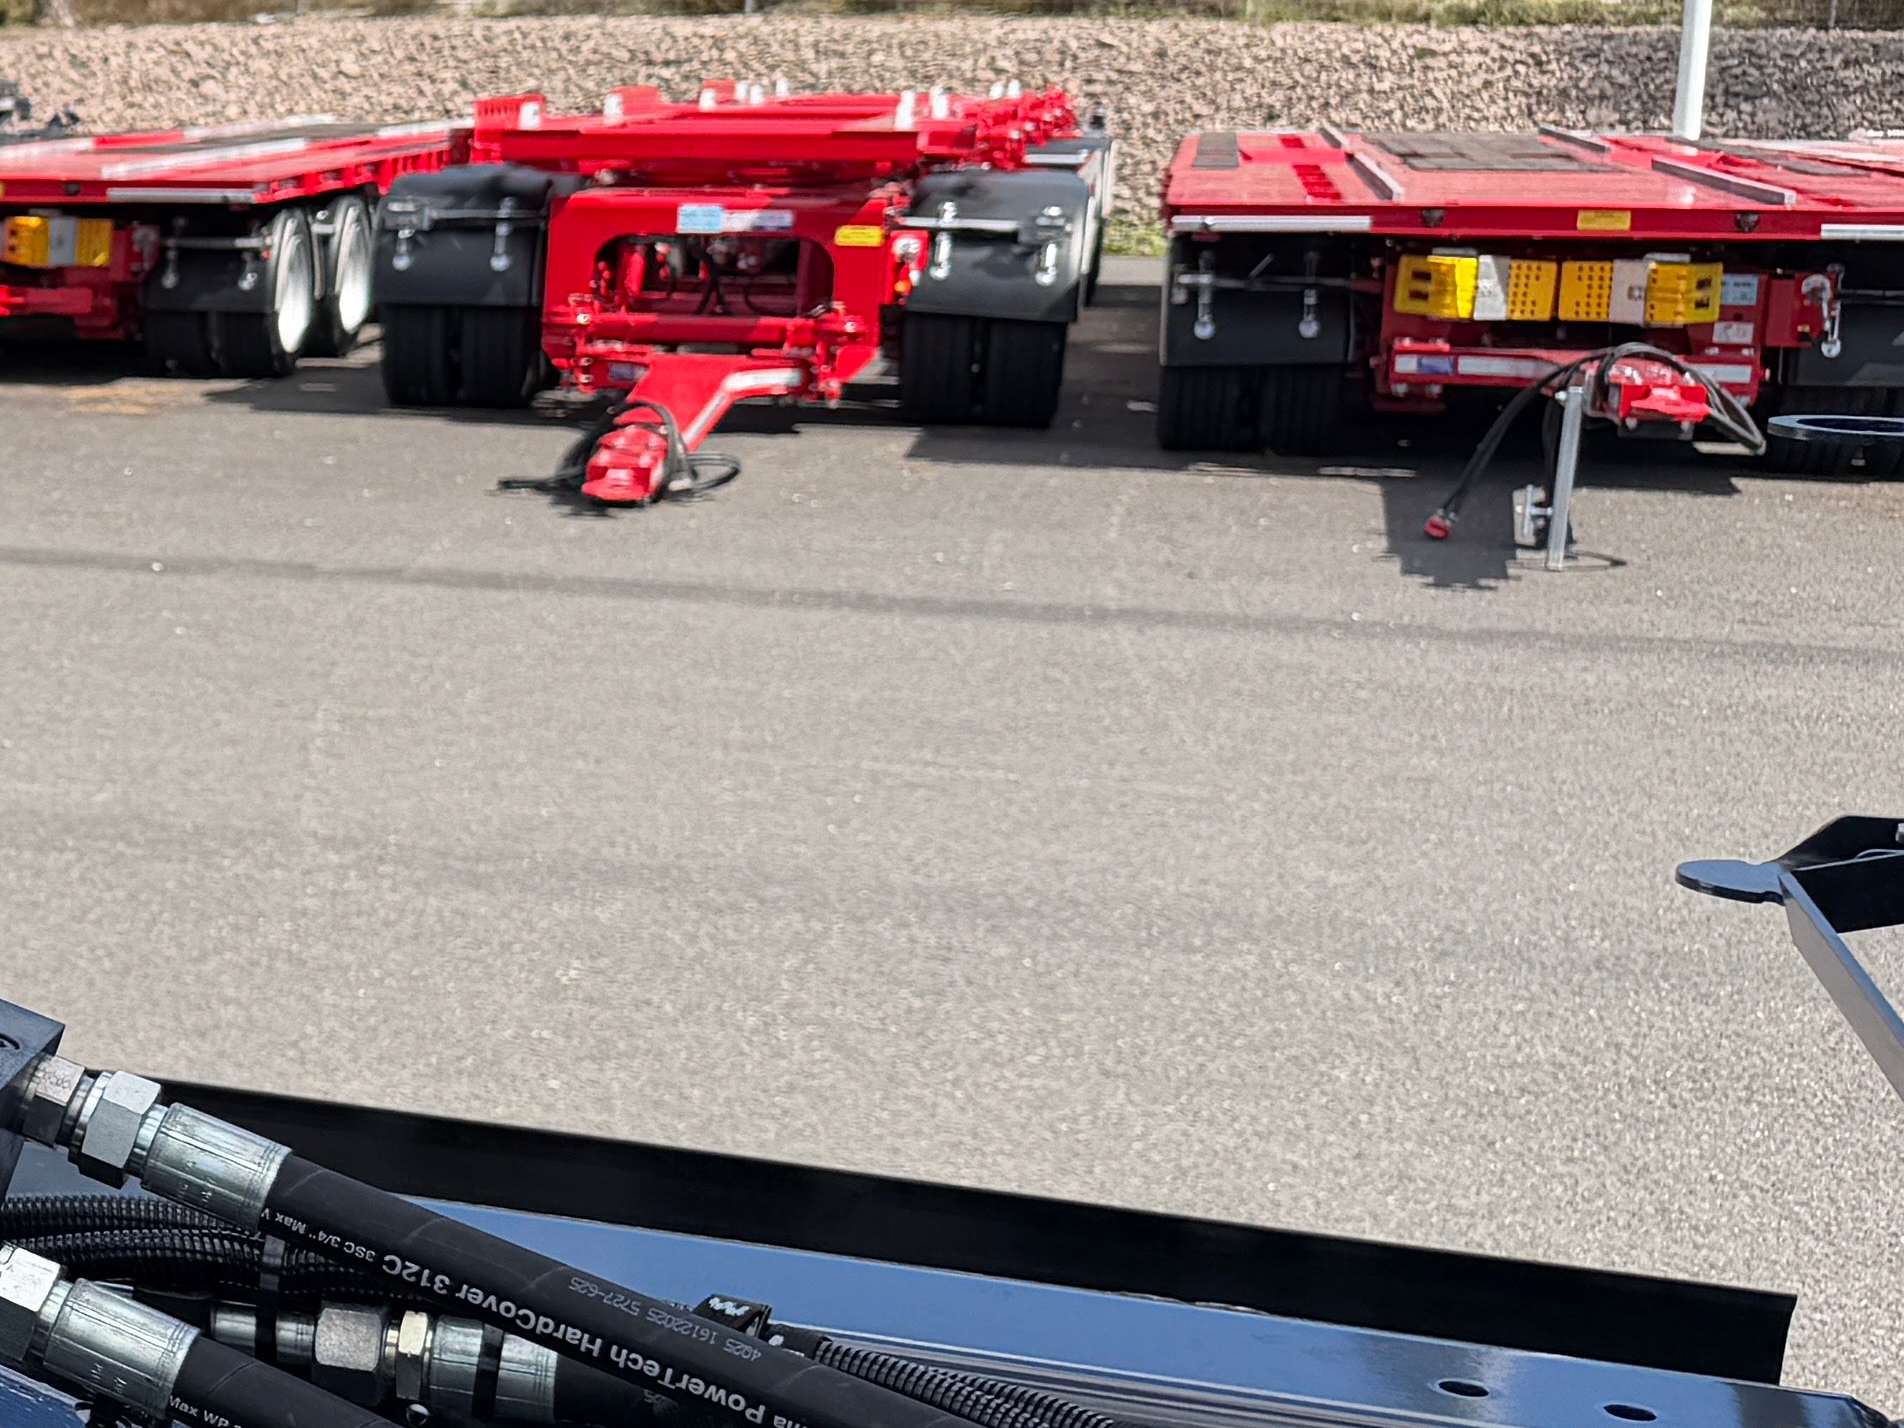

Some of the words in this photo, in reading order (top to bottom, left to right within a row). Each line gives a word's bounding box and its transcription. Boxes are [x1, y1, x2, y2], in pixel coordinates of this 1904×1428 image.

[274, 1212, 307, 1236] Max
[344, 1240, 376, 1262] 3SC
[384, 1254, 450, 1295] 312C
[453, 1281, 604, 1358] HardCover
[610, 1345, 767, 1425] PowerTech
[202, 1410, 230, 1428] WP
